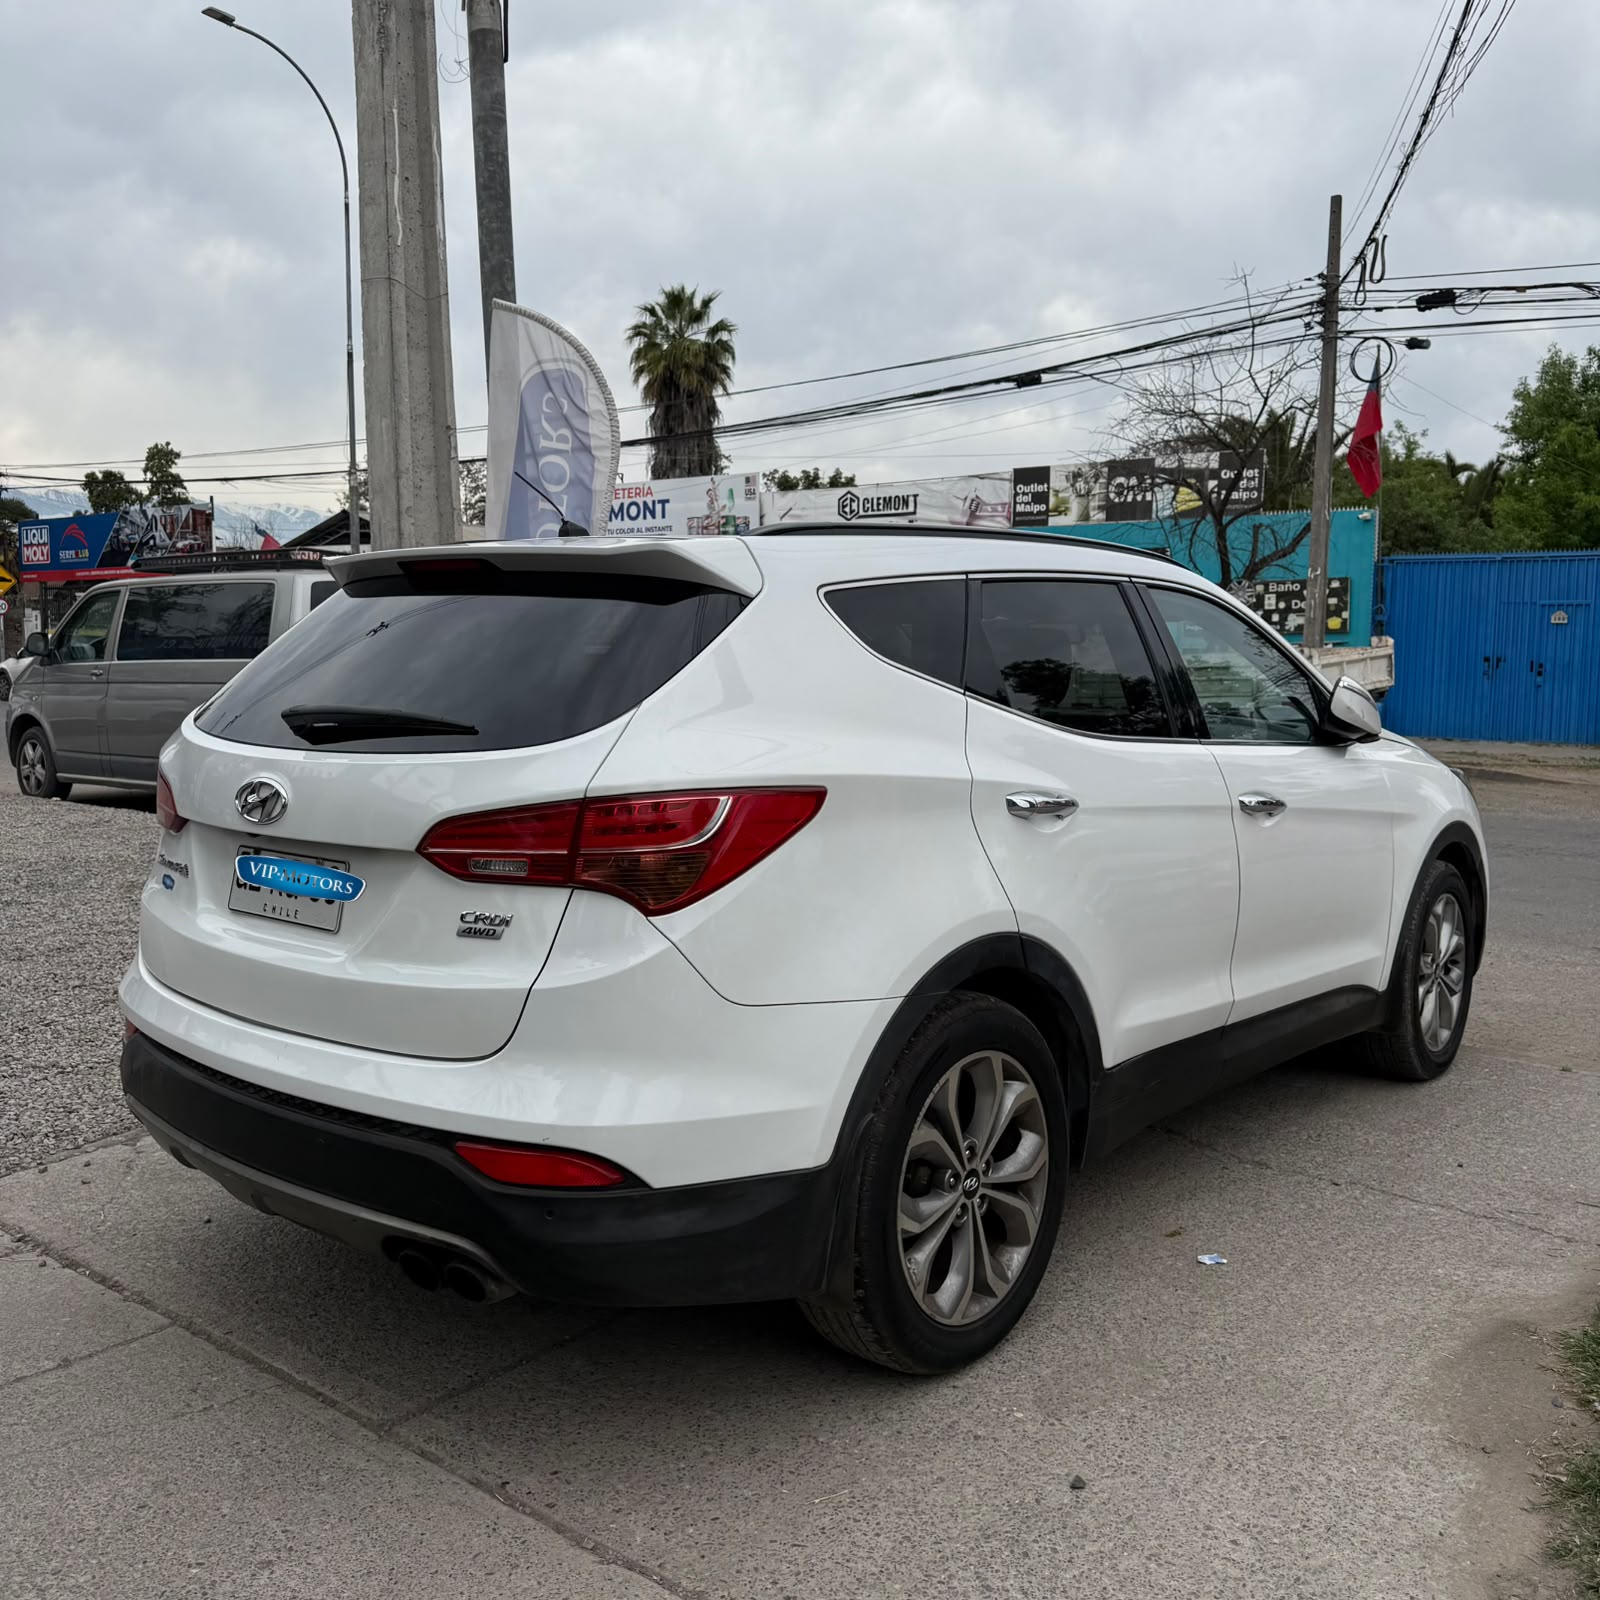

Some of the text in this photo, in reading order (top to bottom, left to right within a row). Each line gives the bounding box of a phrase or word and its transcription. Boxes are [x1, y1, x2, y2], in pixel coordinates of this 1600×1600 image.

[1016, 482, 1048, 493] Outlet
[1016, 493, 1032, 503] del
[862, 494, 919, 514] CLEMONT
[1016, 503, 1047, 514] Maipo
[608, 499, 670, 522] MONT
[615, 527, 636, 536] COLOR
[636, 526, 645, 534] AL
[645, 525, 673, 534] INSTANTE
[22, 528, 48, 545] LIQUI
[23, 545, 49, 562] MOLY
[1268, 581, 1301, 592] Baño
[262, 902, 300, 919] CHILE
[461, 926, 497, 937] 4WD
